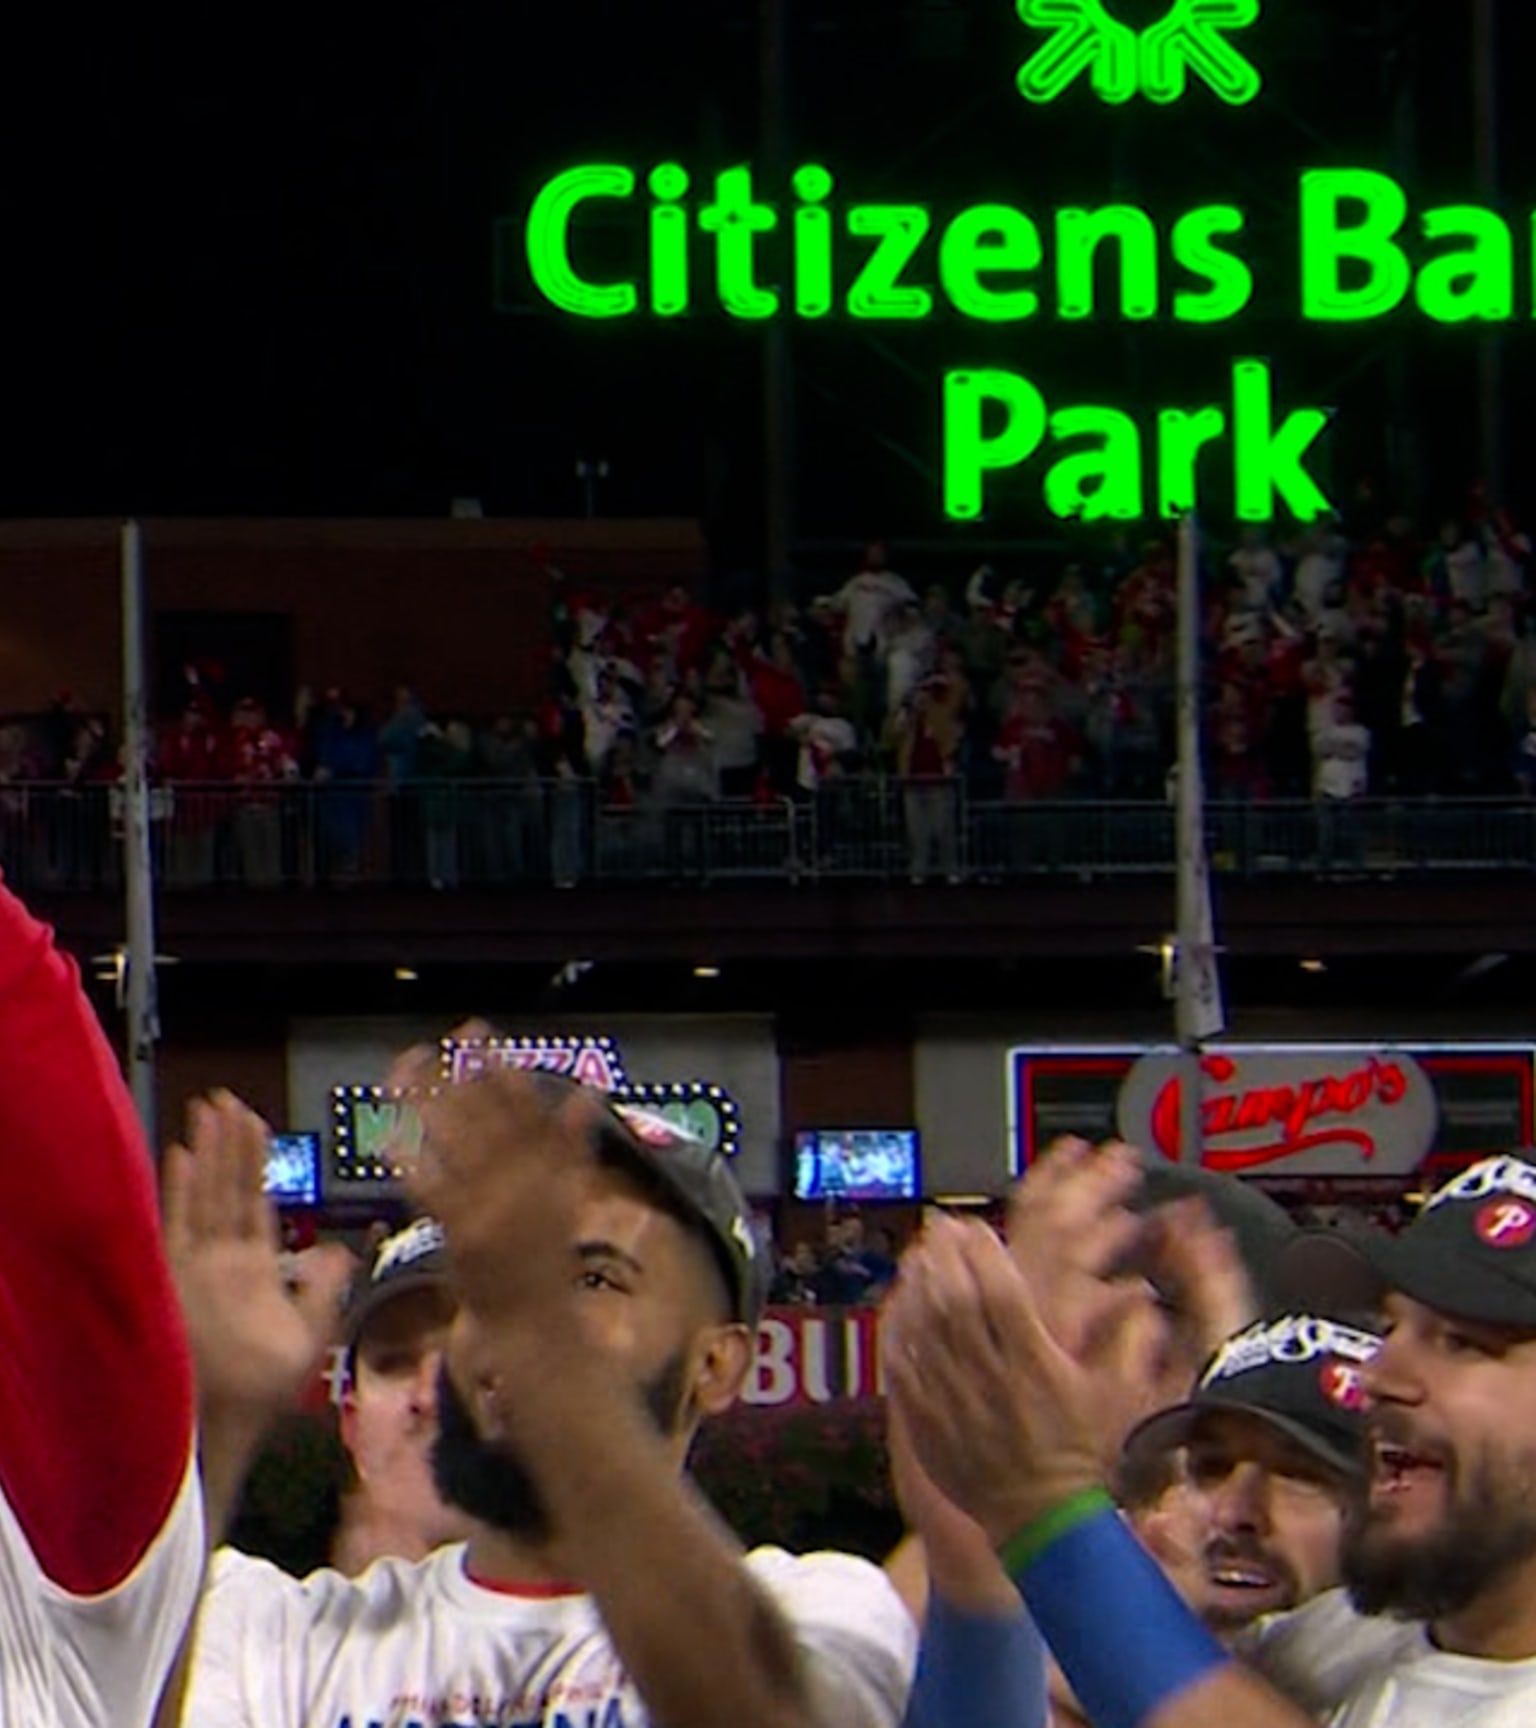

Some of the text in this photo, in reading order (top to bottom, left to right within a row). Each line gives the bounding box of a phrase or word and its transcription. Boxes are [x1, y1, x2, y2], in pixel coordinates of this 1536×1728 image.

[526, 163, 1536, 323] Citizens Ba
[943, 358, 1334, 522] Park
